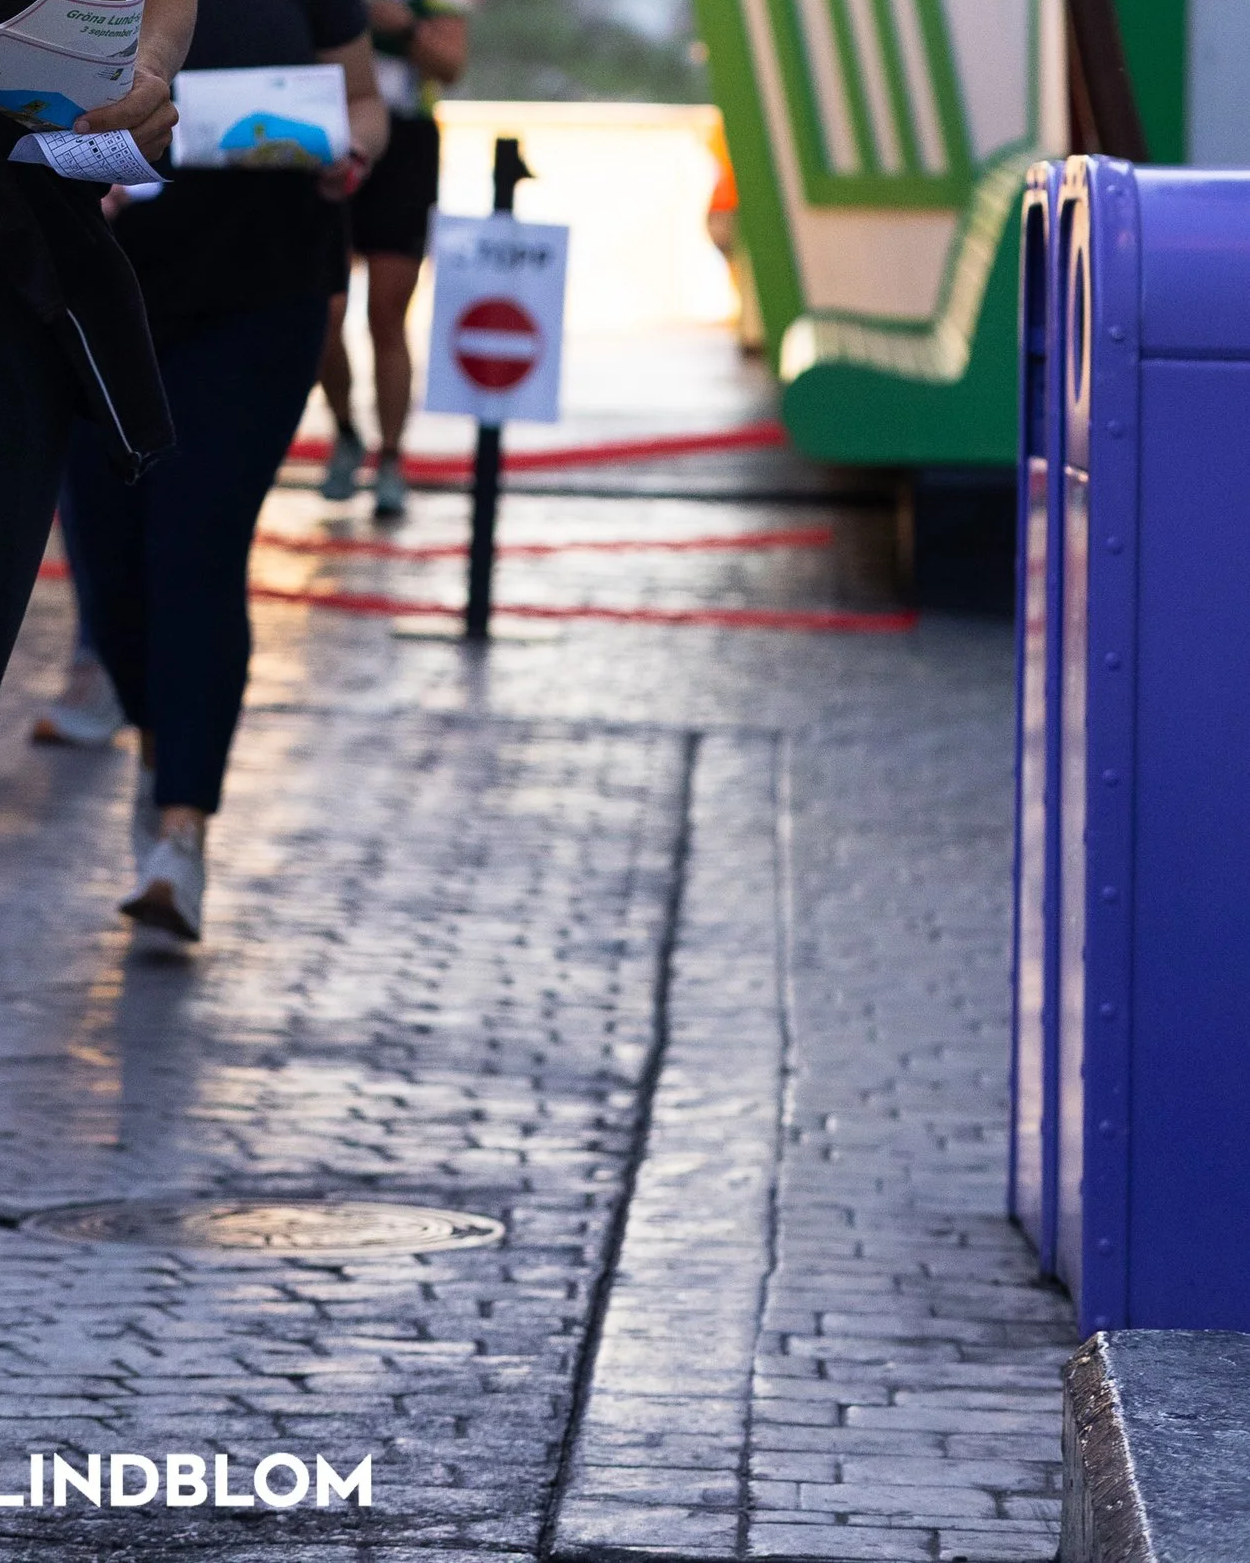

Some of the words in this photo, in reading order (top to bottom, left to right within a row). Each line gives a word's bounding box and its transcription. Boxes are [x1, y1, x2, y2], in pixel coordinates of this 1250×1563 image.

[66, 9, 106, 25] Gröna
[80, 25, 89, 33] 3
[88, 27, 133, 38] september
